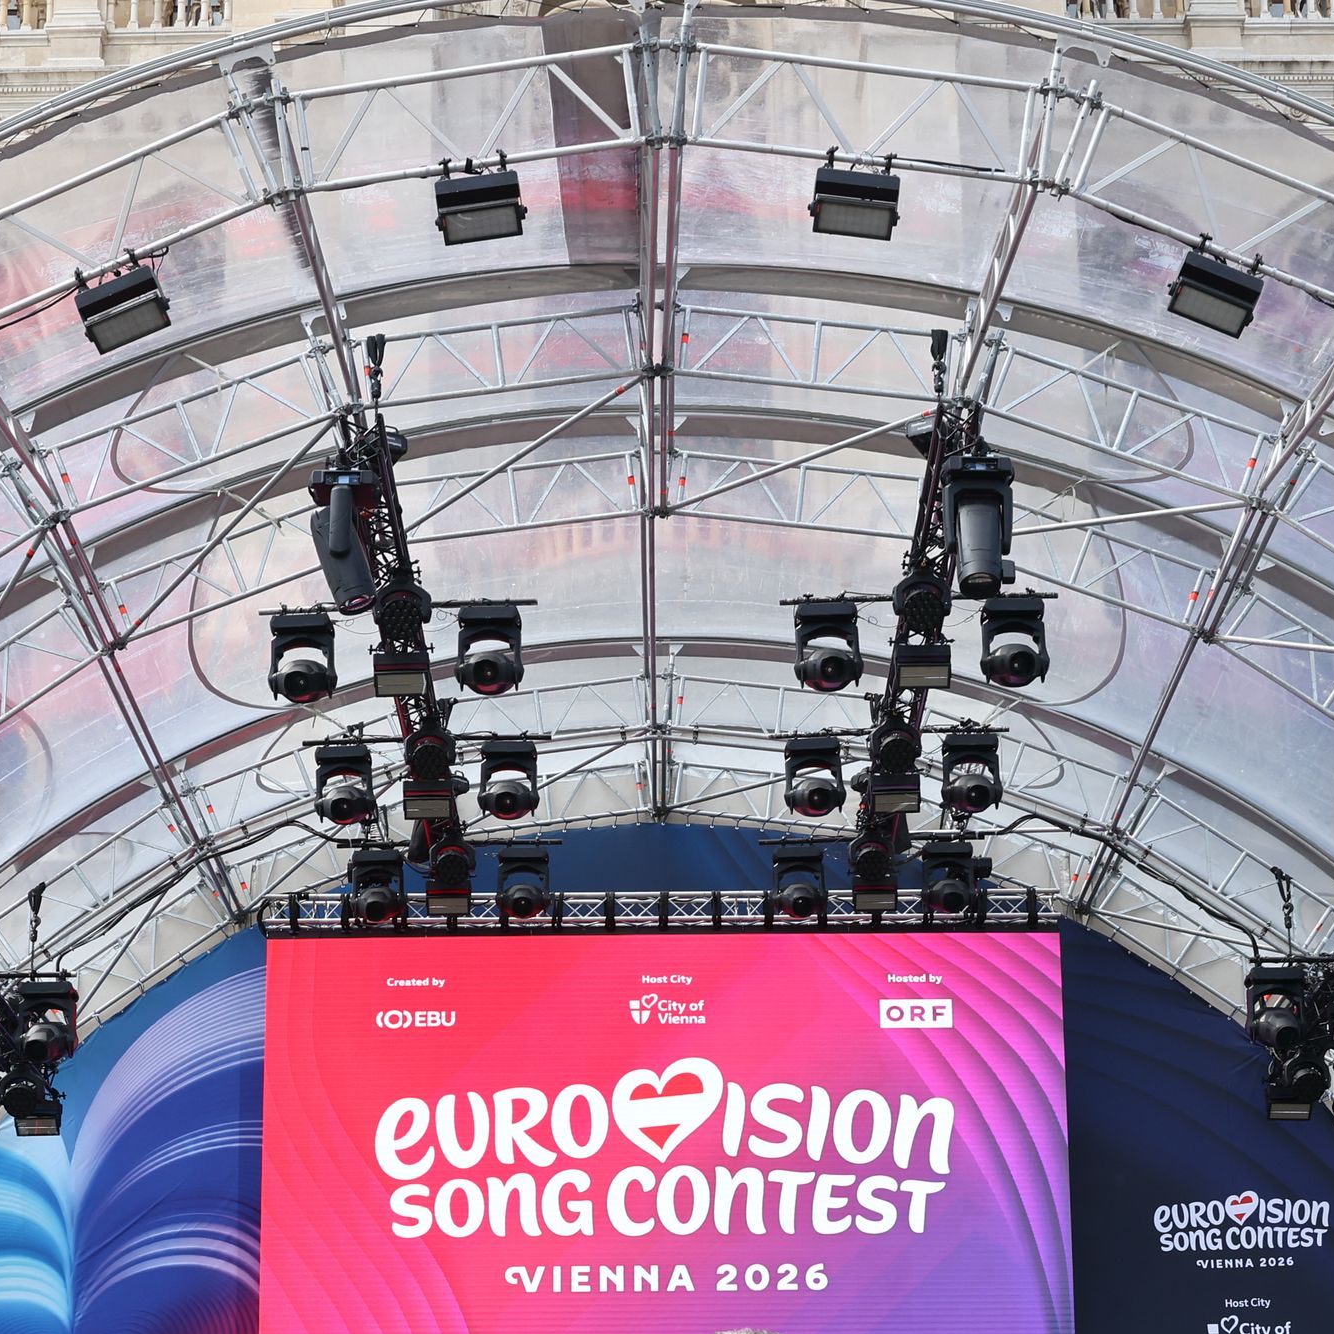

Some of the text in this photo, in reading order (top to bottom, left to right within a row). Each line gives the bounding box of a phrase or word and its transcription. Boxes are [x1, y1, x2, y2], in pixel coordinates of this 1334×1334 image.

[386, 977, 446, 989] Created by
[641, 974, 693, 987] Host City
[887, 973, 943, 985] Hosted by
[657, 999, 705, 1014] City of
[885, 1005, 947, 1022] ORF
[414, 1010, 456, 1028] EBU
[657, 1012, 707, 1025] Vienna
[390, 1165, 947, 1238] SONG CONTEST
[1159, 1226, 1328, 1252] SONG CONTEST
[1196, 1257, 1294, 1269] VIENNA 2026
[505, 1263, 829, 1293] VIENNA 2026
[1224, 1297, 1271, 1309] Host City
